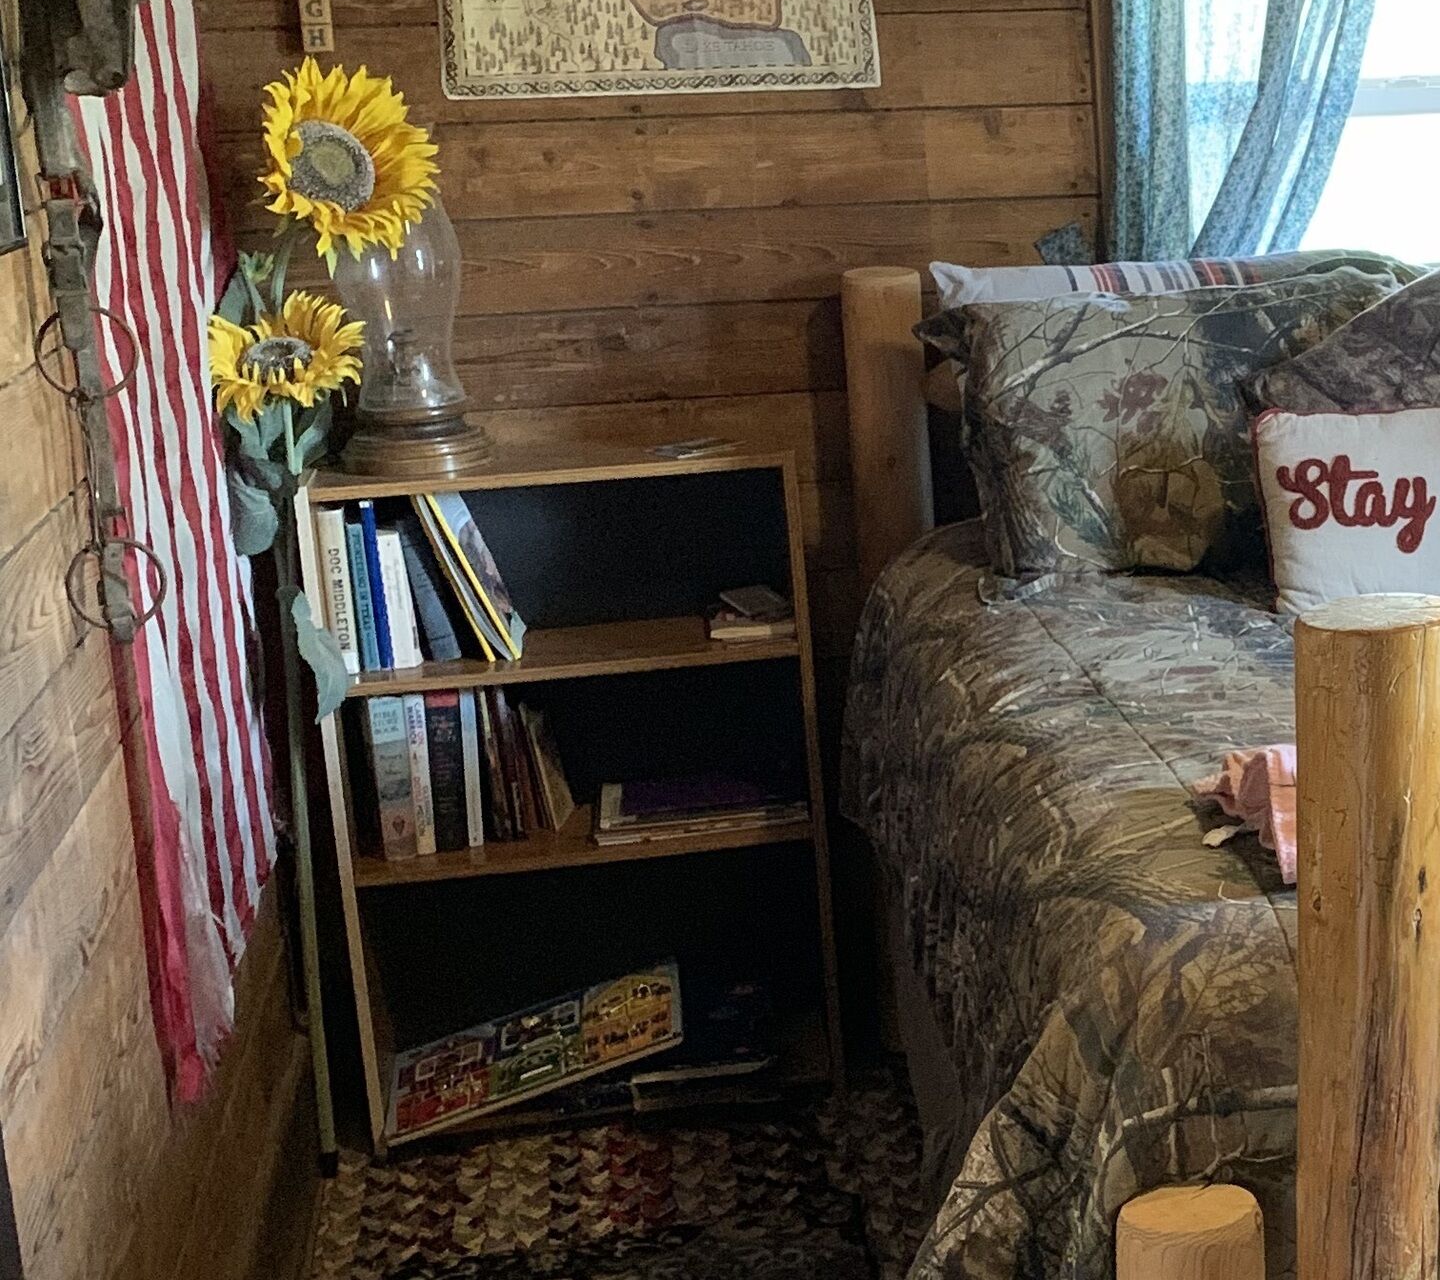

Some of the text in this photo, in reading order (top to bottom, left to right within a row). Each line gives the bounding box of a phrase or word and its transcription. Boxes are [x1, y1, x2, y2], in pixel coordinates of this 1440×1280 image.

[1276, 454, 1437, 553] Stay
[327, 547, 351, 651] DOC MIDDLETON
